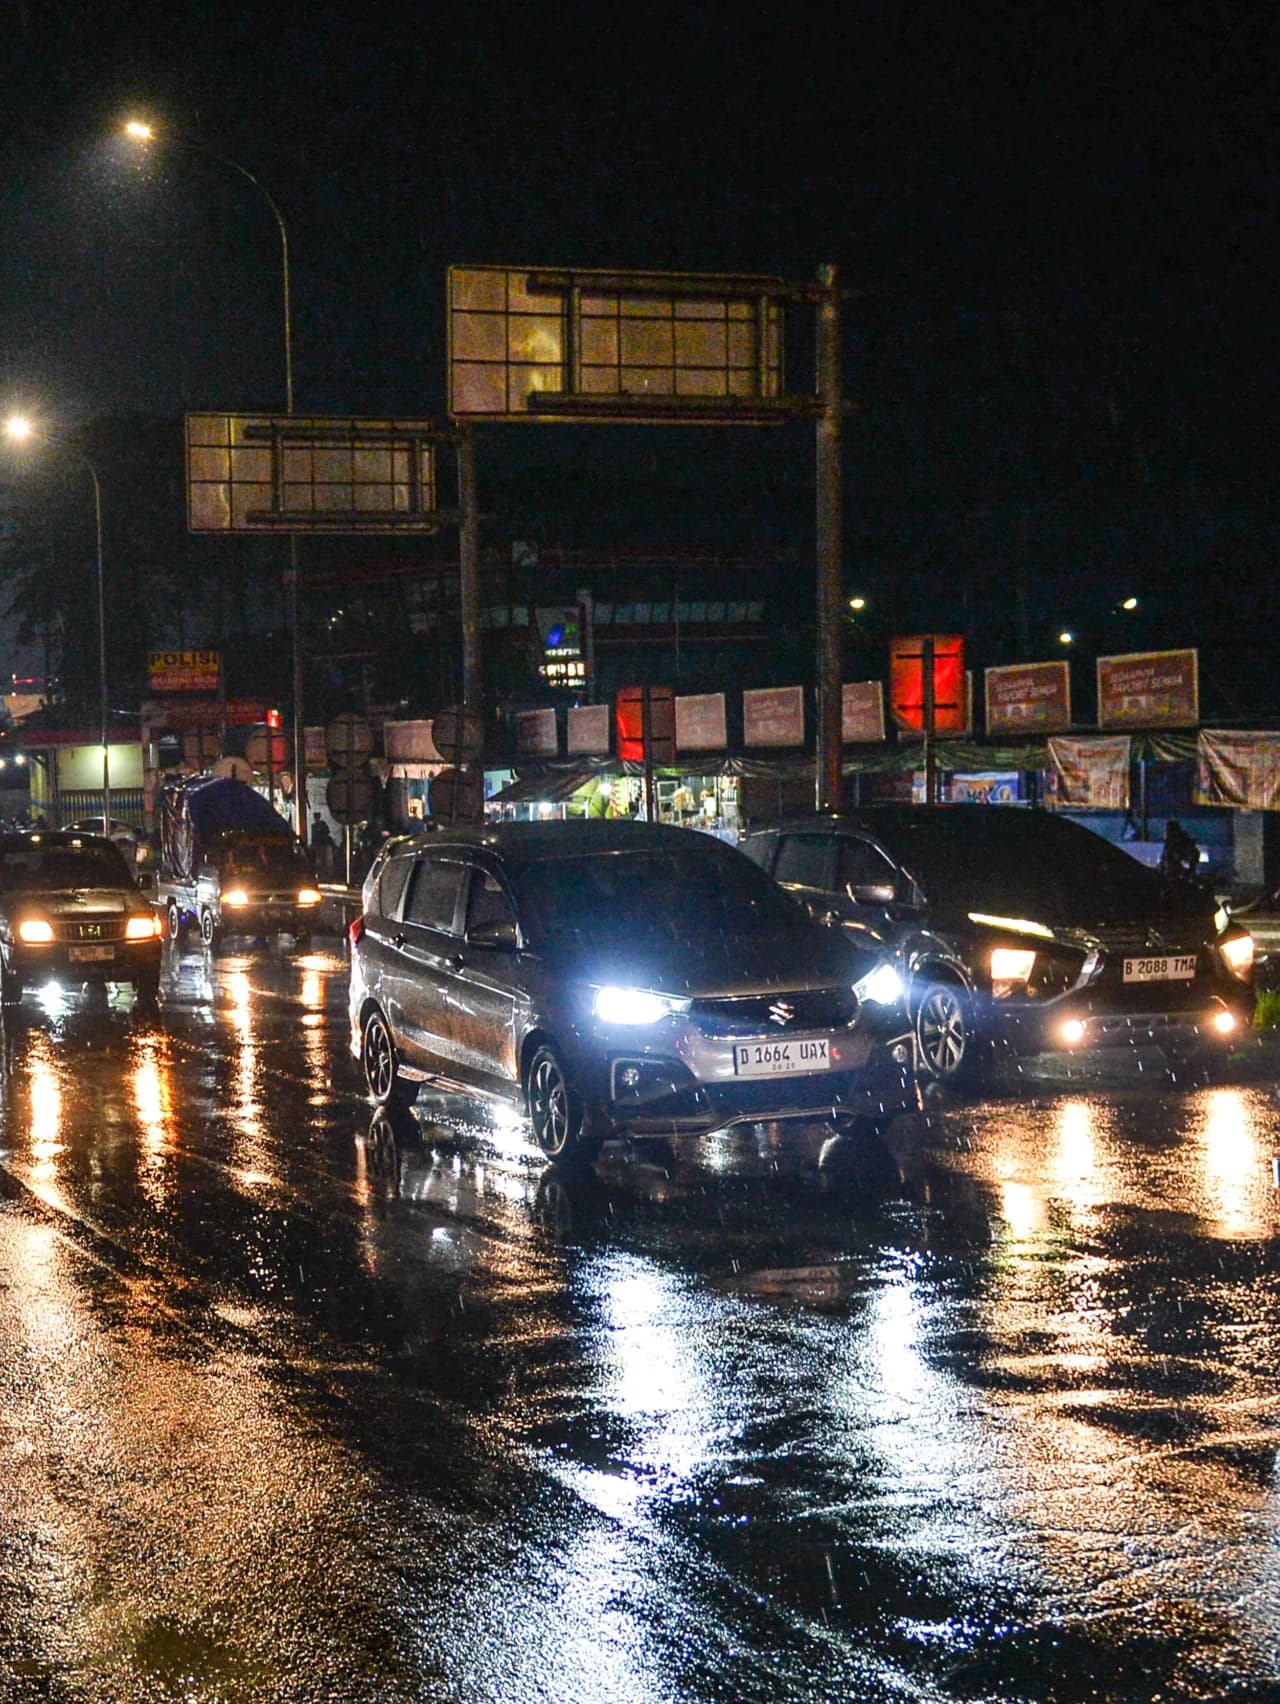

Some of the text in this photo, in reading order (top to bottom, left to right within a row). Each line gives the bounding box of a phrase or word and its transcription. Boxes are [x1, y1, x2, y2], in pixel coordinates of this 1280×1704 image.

[150, 652, 218, 667] POLISI
[1125, 961, 1133, 975] B
[1138, 959, 1168, 974] 2088
[740, 1042, 827, 1065] D 1664 UAX
